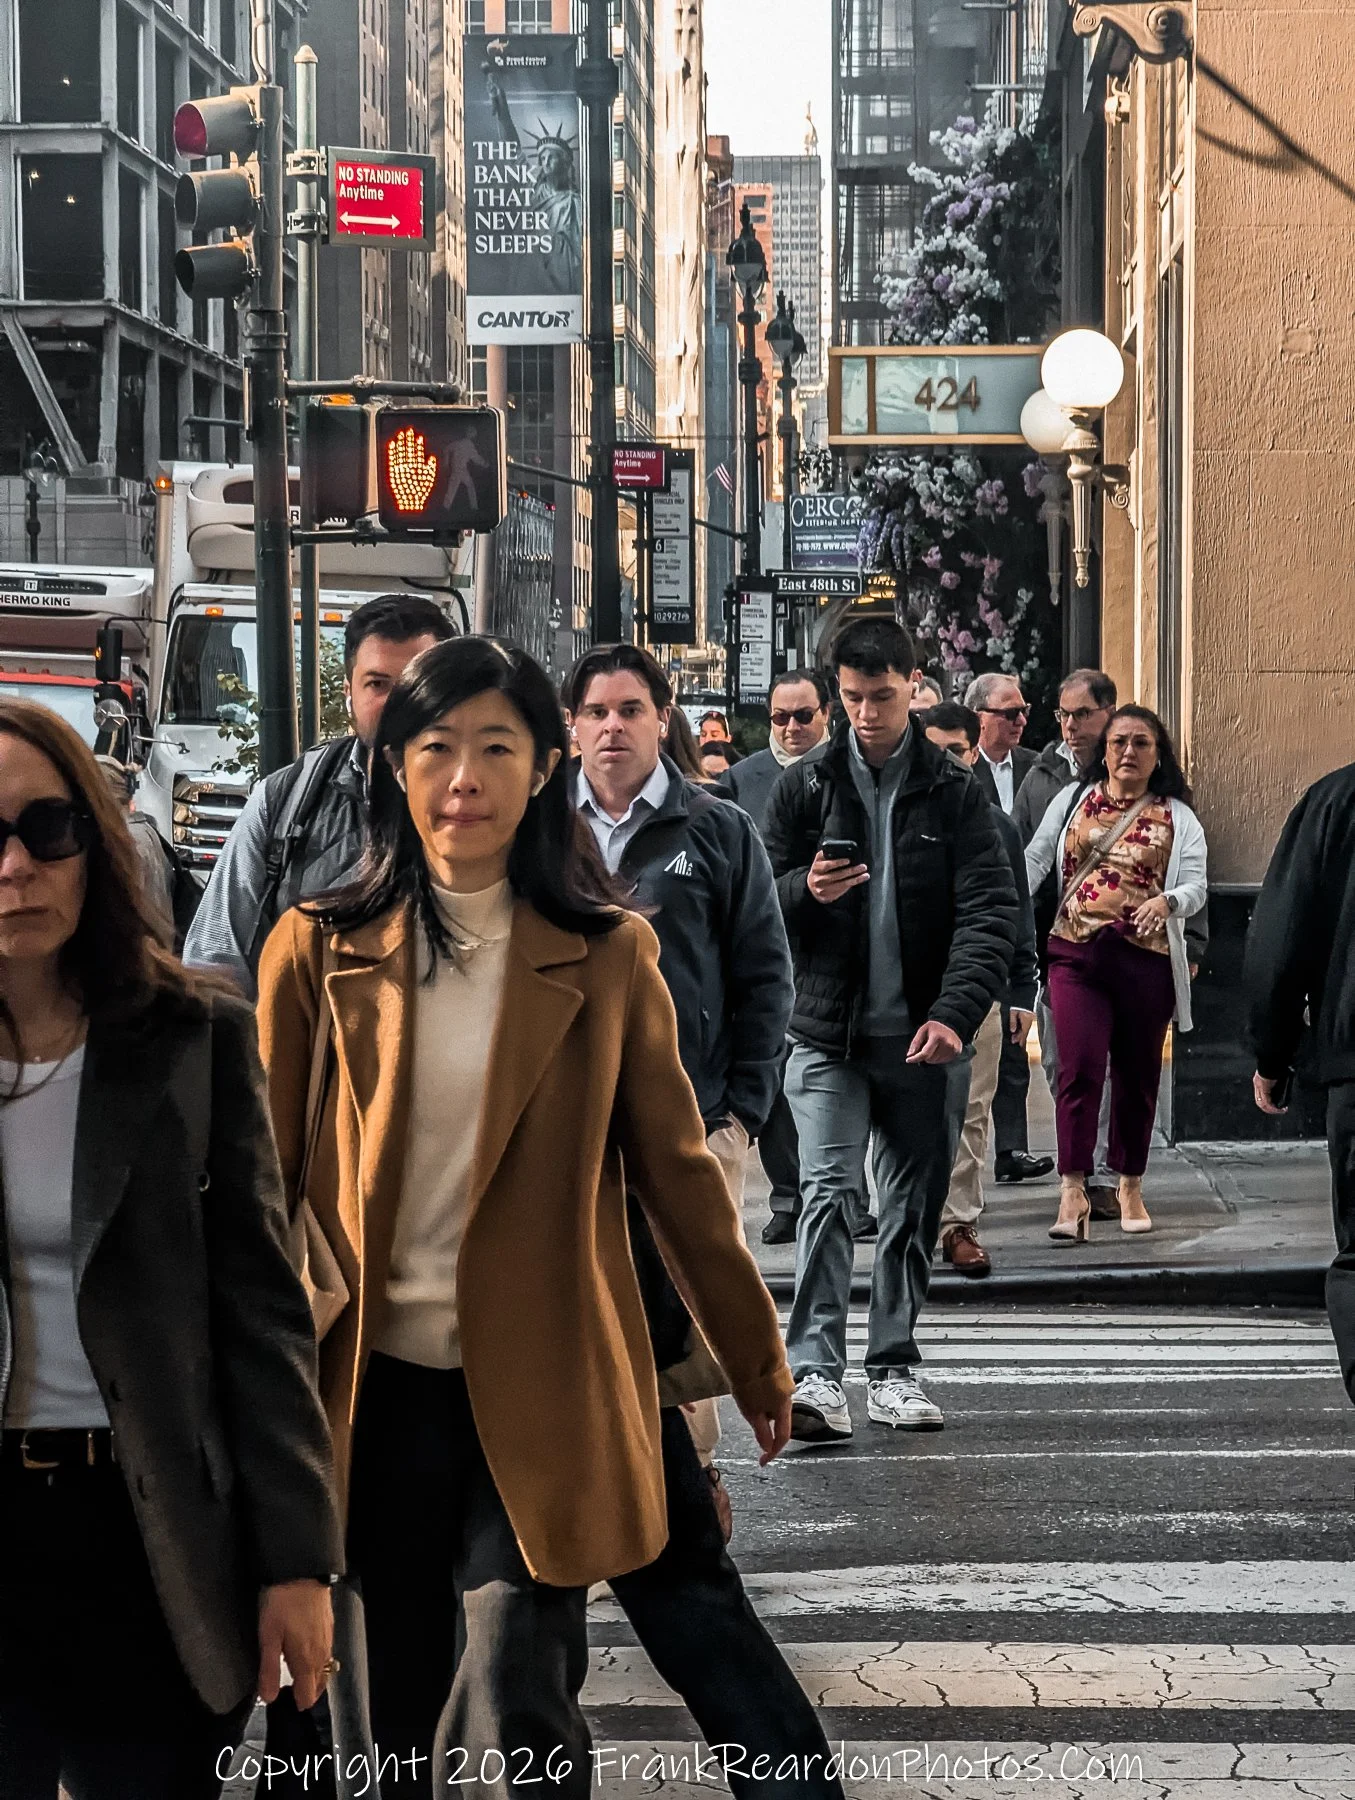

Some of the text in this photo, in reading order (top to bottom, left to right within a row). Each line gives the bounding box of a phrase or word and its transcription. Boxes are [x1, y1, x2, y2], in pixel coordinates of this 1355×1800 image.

[472, 141, 518, 160] THE
[338, 166, 409, 186] NO STANDING
[474, 165, 537, 184] BANK
[339, 183, 384, 202] Anytime
[473, 188, 535, 207] THAT
[475, 211, 550, 230] NEVER
[475, 235, 553, 254] SLEEPS
[477, 311, 570, 328] CANTOR
[914, 375, 981, 412] 424
[614, 450, 656, 459] NO STANDING
[614, 459, 641, 468] Anytime
[655, 539, 662, 552] 6
[778, 577, 856, 591] East 48th St
[42, 596, 71, 606] KING
[741, 643, 748, 653] 6
